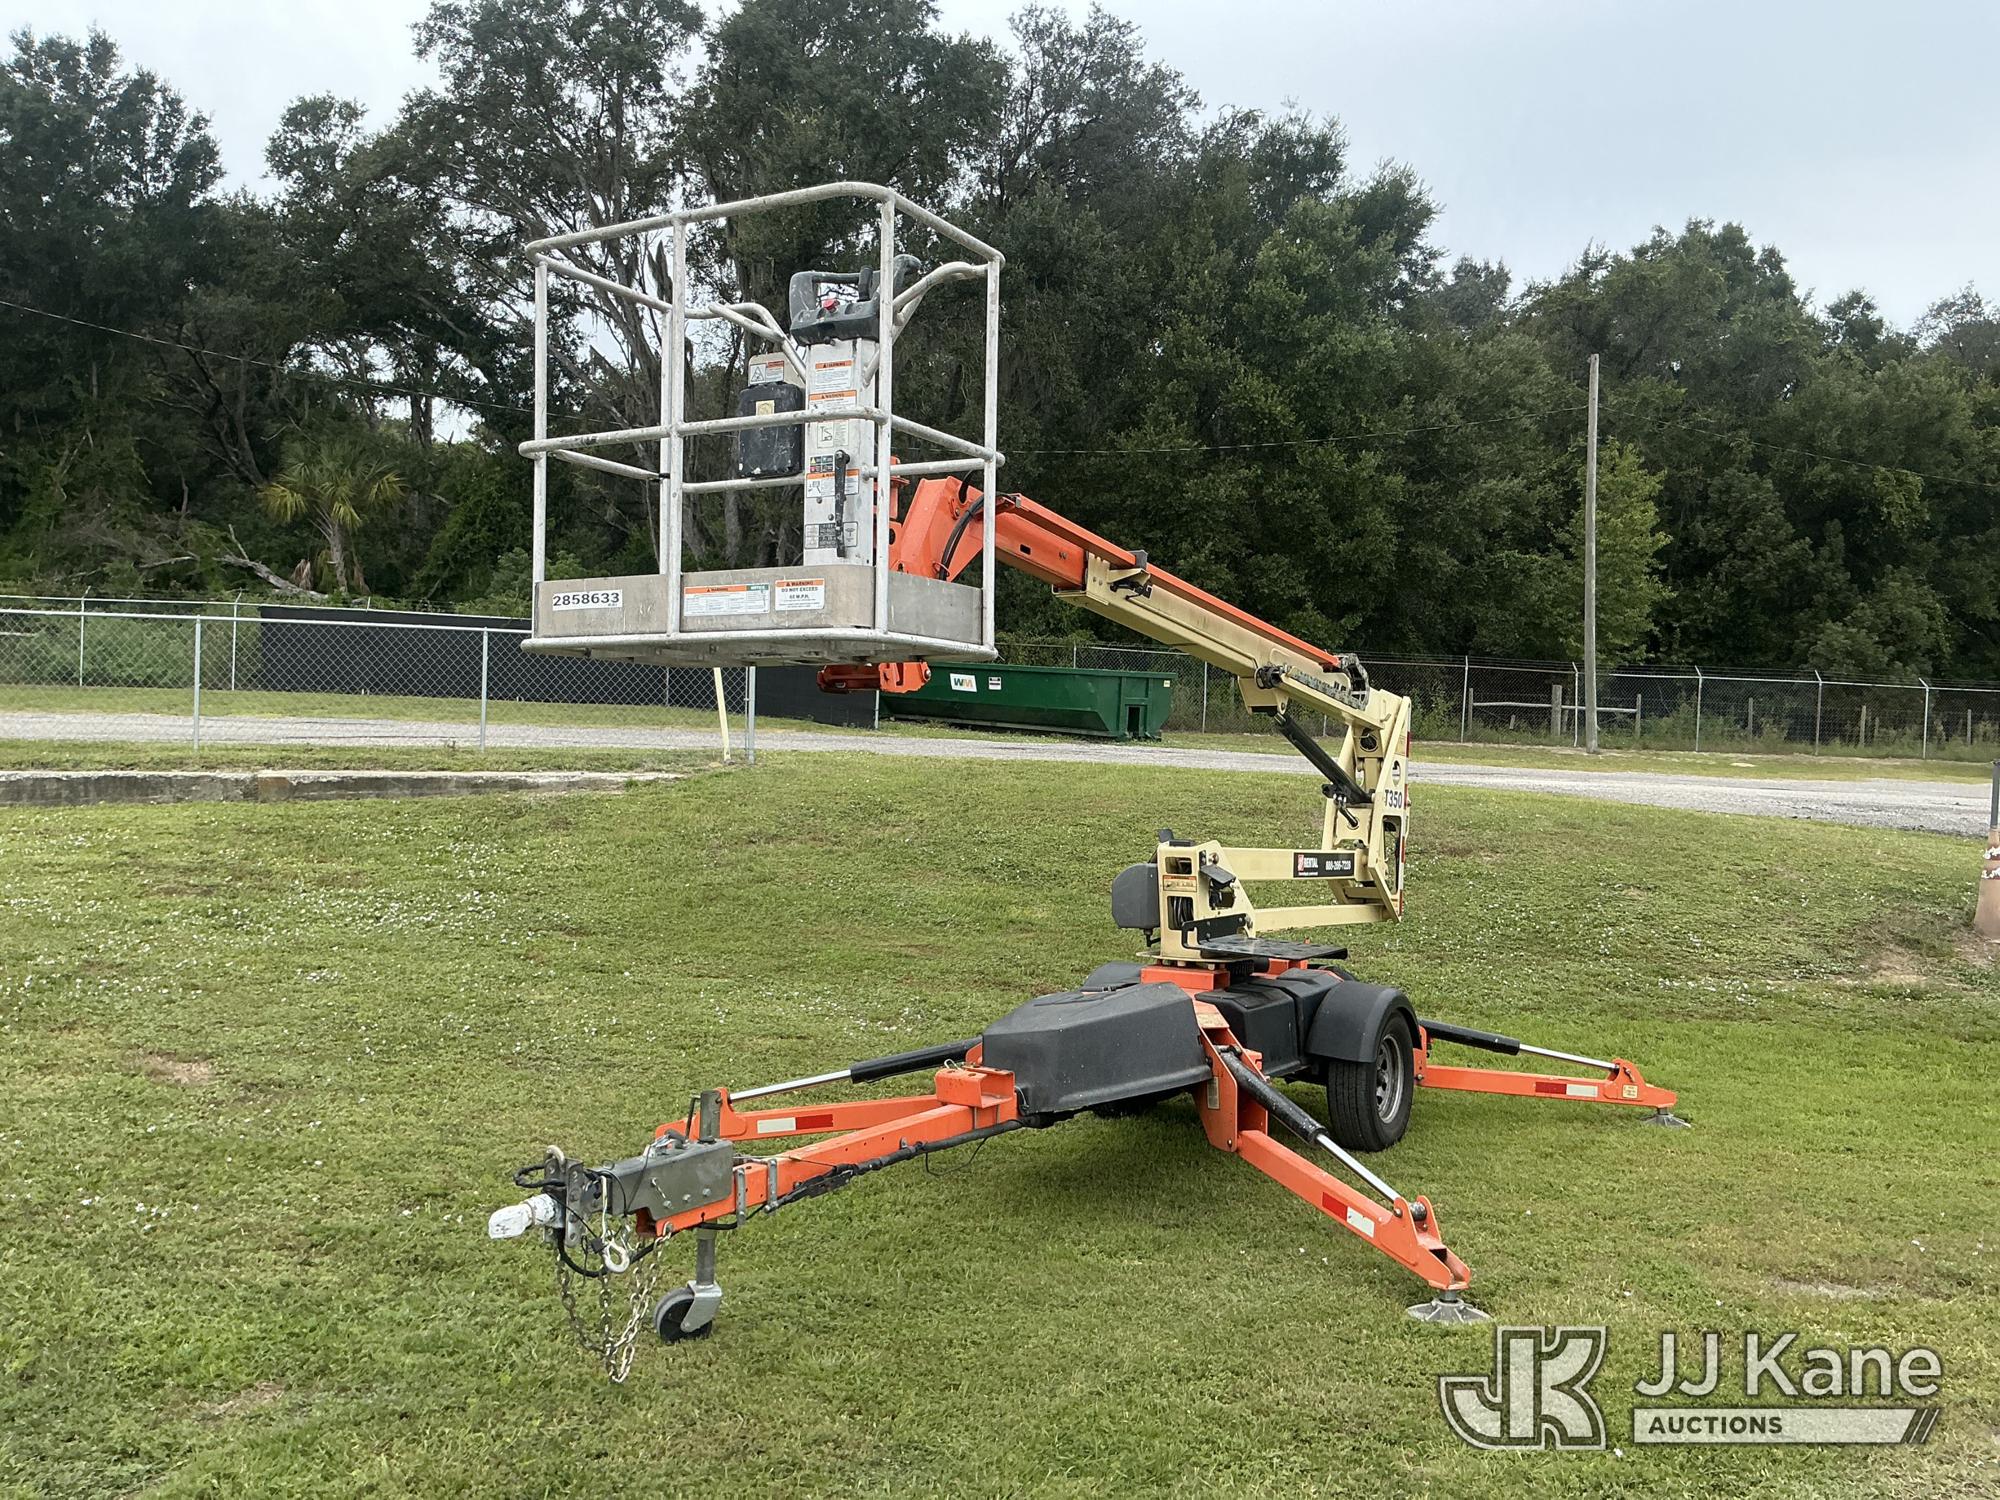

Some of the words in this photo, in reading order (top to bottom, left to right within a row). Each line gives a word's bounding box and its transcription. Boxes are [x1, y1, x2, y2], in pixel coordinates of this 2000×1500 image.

[552, 592, 620, 606] 2858633
[953, 677, 974, 688] WM
[1384, 789, 1403, 809] T350
